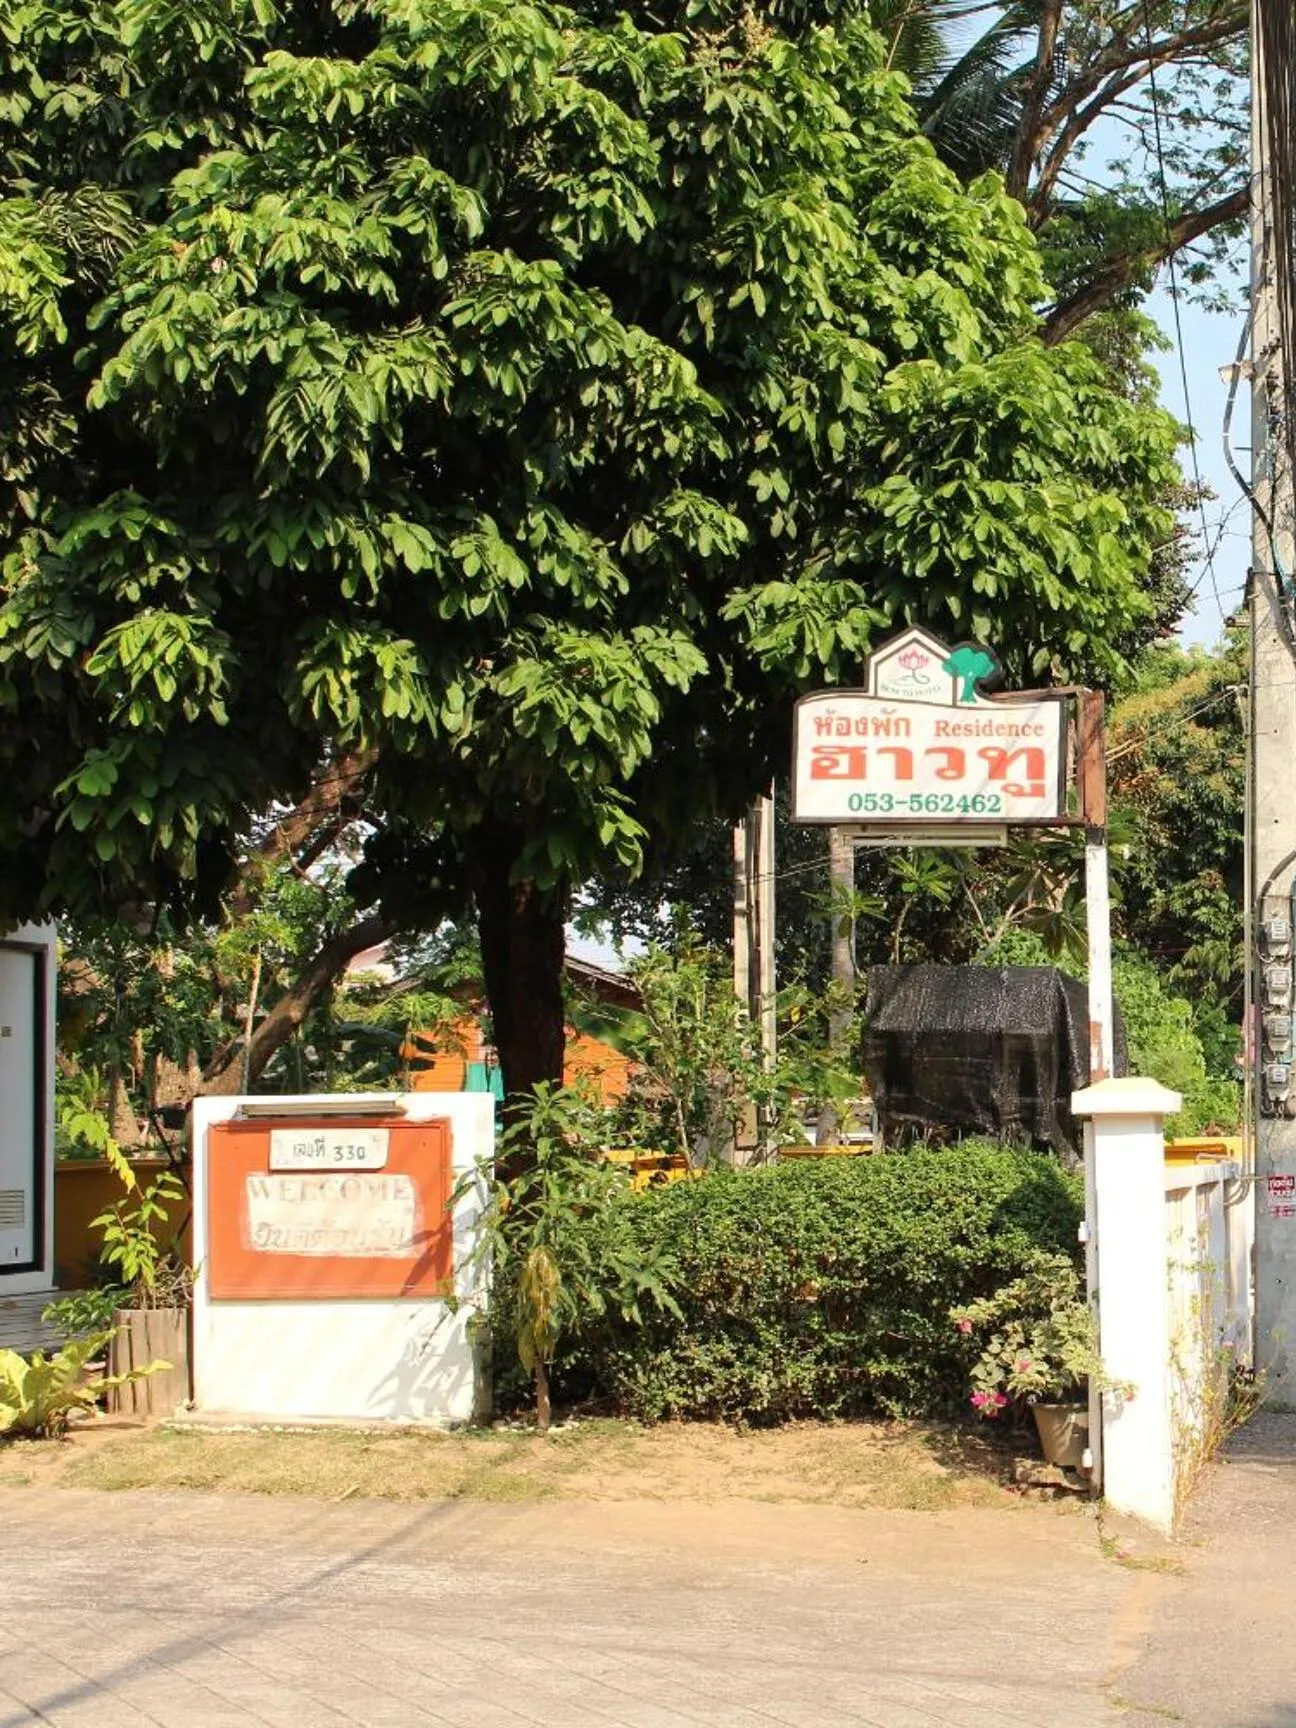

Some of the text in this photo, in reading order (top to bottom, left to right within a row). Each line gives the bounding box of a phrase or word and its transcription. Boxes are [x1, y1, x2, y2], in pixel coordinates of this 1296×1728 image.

[814, 707, 911, 737] ห้องพัก
[934, 719, 1045, 738] Residence
[810, 745, 1046, 798] ฮาวทู
[848, 792, 1002, 813] 053-562462
[333, 1145, 366, 1161] 330
